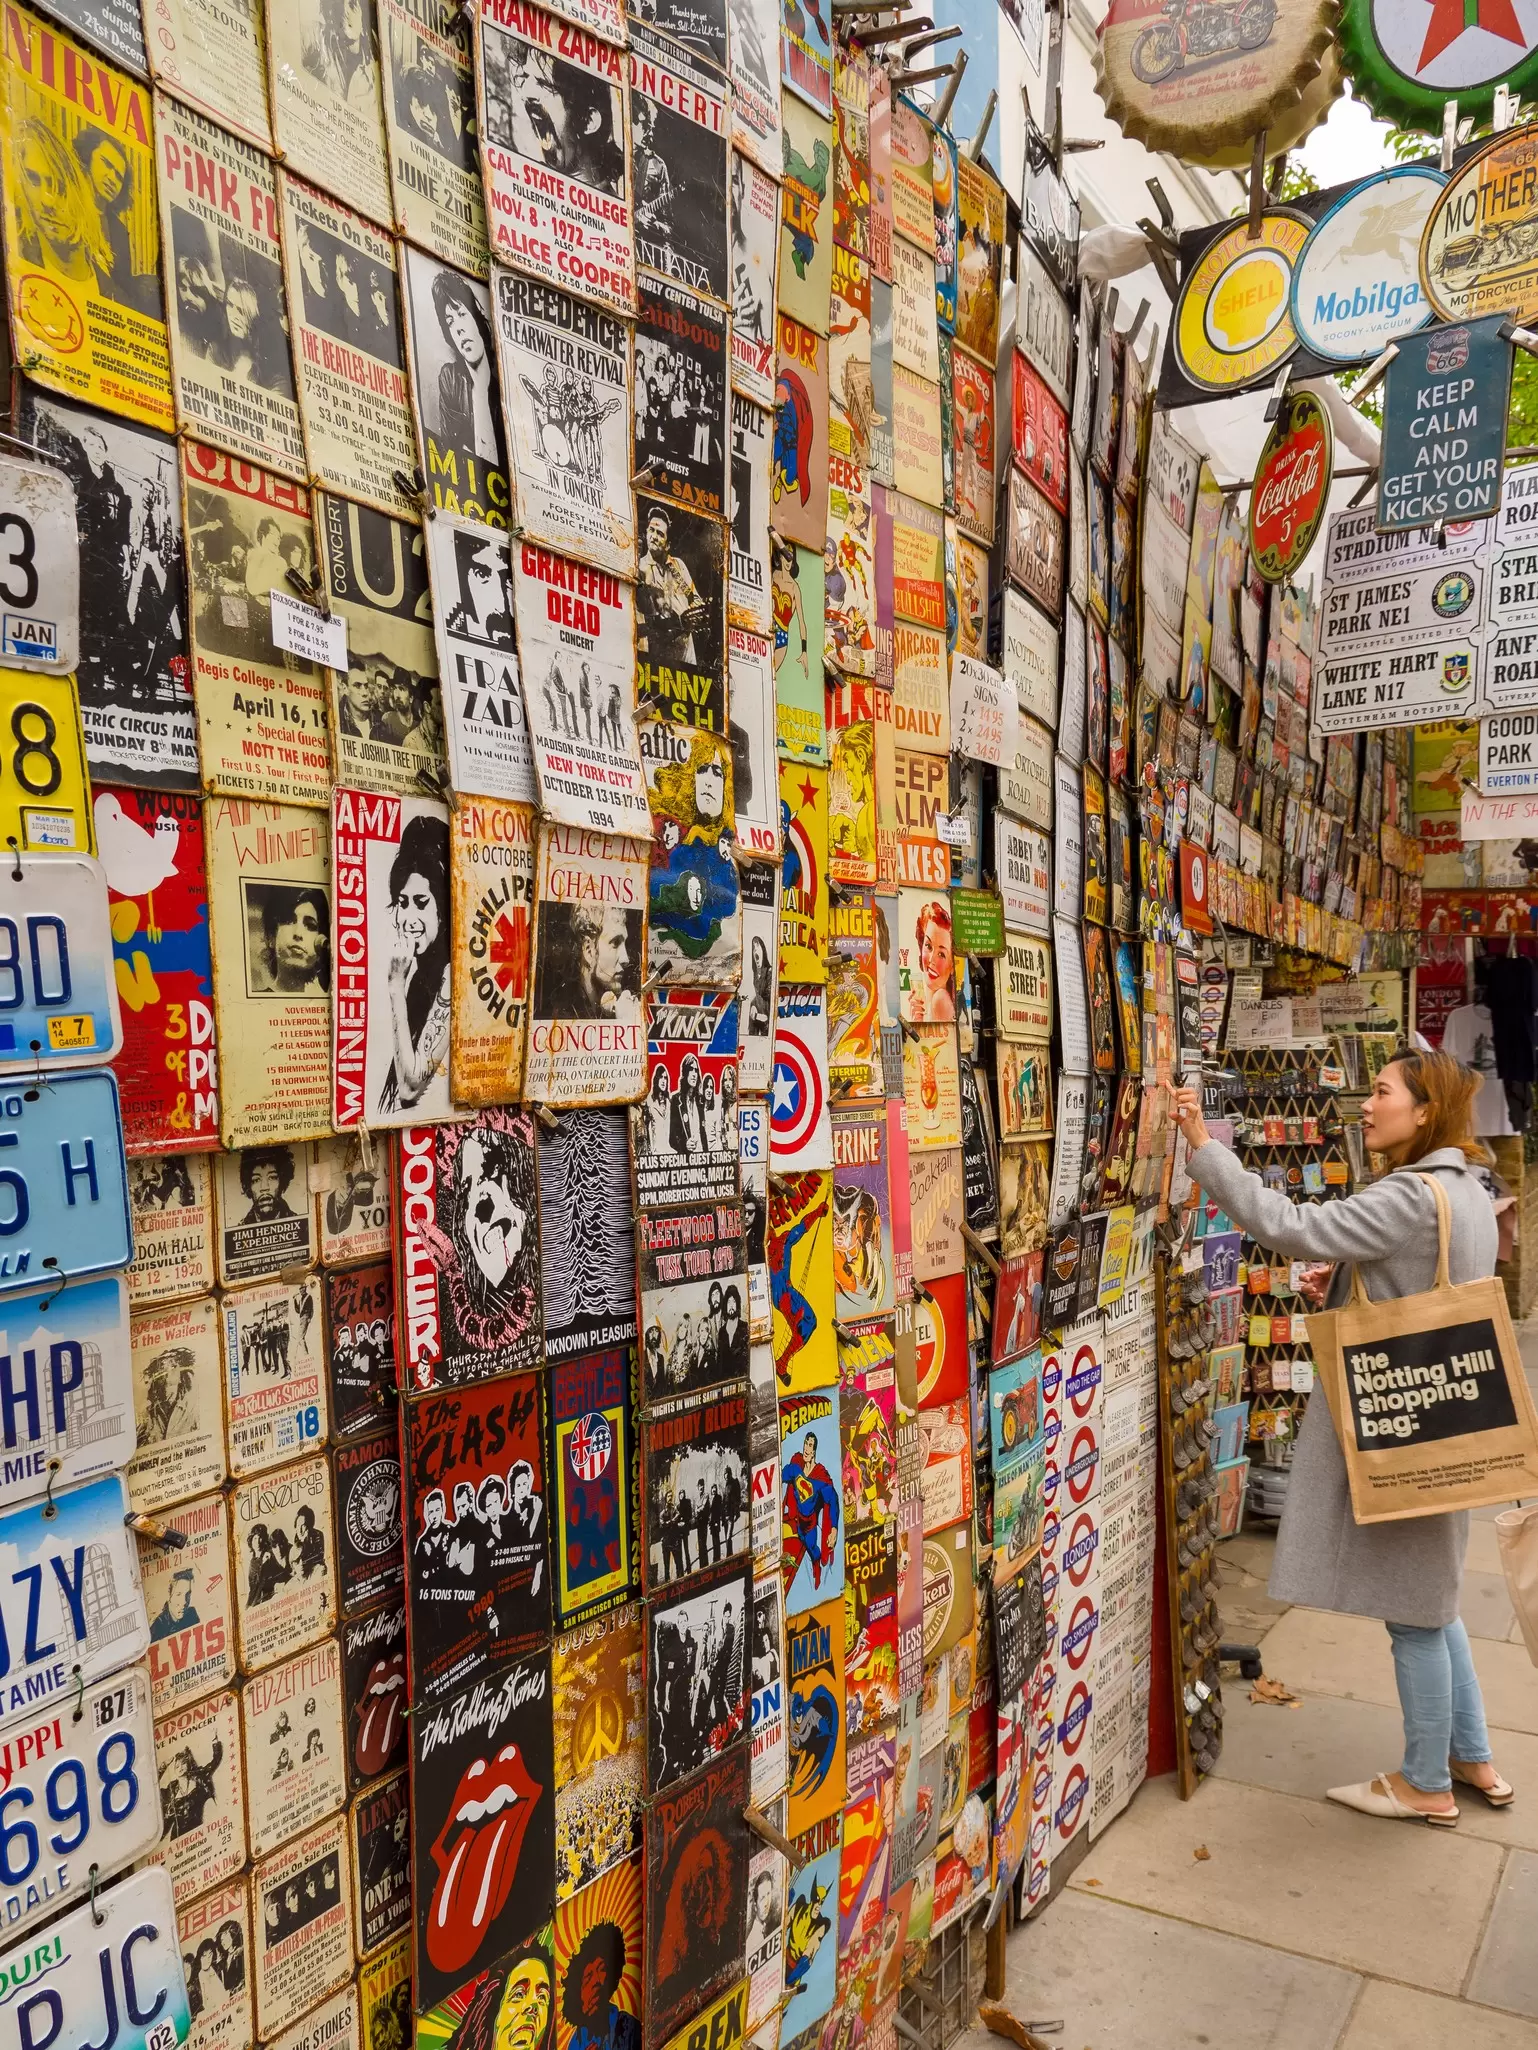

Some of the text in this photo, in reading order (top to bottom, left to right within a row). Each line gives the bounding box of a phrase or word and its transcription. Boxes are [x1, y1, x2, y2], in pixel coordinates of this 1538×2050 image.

[558, 15, 623, 82] ZAPPA
[660, 38, 692, 65] ROTTERDAM
[487, 147, 628, 228] CAL. STATE COLLEGE
[752, 168, 775, 192] EDWARD
[187, 196, 245, 245] SATURDAY
[286, 187, 392, 264] Tickets On Sale
[560, 205, 606, 233] CALIFORNIA
[551, 218, 584, 249] 1972
[554, 238, 574, 253] ALSO
[497, 227, 632, 301] ALICE COOPER
[665, 286, 724, 324] CENTER TULSA
[1450, 277, 1533, 307] MOTORCYCLE
[87, 300, 124, 321] BRISTOL
[89, 325, 125, 345] LONDON
[575, 350, 626, 388] REVIVAL
[179, 377, 220, 404] CAPTAIN
[220, 375, 295, 422] THE STEVE MILLER
[352, 385, 386, 411] STADIUM
[1417, 378, 1475, 411] KEEP
[196, 423, 228, 445] TICKETS
[214, 407, 265, 443] HARPER
[1409, 406, 1477, 439] CALM
[1275, 449, 1297, 474] DRINK
[1415, 438, 1468, 468] AND
[666, 460, 689, 476] GUESTS
[1383, 458, 1497, 498] GET YOUR
[563, 474, 603, 509] CONCERT
[672, 479, 720, 510] SAXON
[1386, 484, 1490, 522] KICKS ON
[541, 509, 575, 532] MUSIC
[548, 502, 587, 525] FOREST
[1334, 533, 1410, 564] STADIUM
[520, 546, 623, 611] GRATEFUL
[1330, 579, 1419, 613] ST JAMES'
[293, 616, 303, 626] FOR
[546, 588, 600, 637] DEAD
[1328, 606, 1410, 637] PARK NE1
[11, 621, 53, 645] JAN
[294, 629, 305, 640] FOR
[559, 629, 595, 652] CONCERT
[746, 634, 768, 657] BOND
[1334, 630, 1441, 652] NEWCASTLE UNITED
[40, 649, 54, 661] 16
[894, 629, 940, 670] SARCASM
[1325, 651, 1439, 686] WHITE HART
[233, 692, 274, 720] April
[974, 685, 998, 706] SIGNS
[1322, 682, 1405, 710] LANE N17
[119, 716, 169, 737] CIRCUS
[895, 705, 942, 737] DAILY
[1327, 703, 1460, 727] TOTTENHAM HOTSPUR
[257, 721, 295, 745] Special
[536, 735, 640, 772] MADISON SQUARE GARDEN
[1487, 742, 1532, 765] PARK
[546, 754, 632, 789] NEW YORK CITY
[1487, 774, 1530, 788] EVERTON
[544, 775, 594, 800] OCTOBER
[337, 791, 401, 839] AMY
[589, 810, 614, 828] 1994
[482, 843, 533, 869] OCTOBRE
[1007, 832, 1033, 861] ABBEY
[1008, 858, 1031, 885] ROAD
[1008, 944, 1035, 972] BAKER
[337, 834, 368, 1126] WINEHOUSE
[1009, 971, 1038, 995] STREET
[52, 1020, 62, 1030] KY
[73, 1018, 84, 1037] 7
[659, 1005, 715, 1043] KINKS
[58, 1036, 91, 1048] G405877
[531, 1024, 642, 1053] CONCERT
[556, 1084, 604, 1096] NOVEMBER
[660, 1151, 732, 1167] SPECIAL GUEST STARS
[638, 1167, 708, 1189] SUNDAY EVENING,
[232, 1221, 301, 1242] JIMI HENDRIX
[234, 1231, 299, 1250] EXPERIENCE
[641, 1205, 741, 1251] FLEETWOOD MAC
[174, 1263, 203, 1279] 1970
[656, 1245, 733, 1281] TUSK TOUR 1979
[1049, 1282, 1077, 1302] PARKING
[446, 1338, 527, 1368] THURSDAY APRIL
[1106, 1339, 1138, 1364] DRUG FREE
[1351, 1353, 1390, 1375] the
[1067, 1369, 1100, 1393] MIND THE GAP
[1115, 1359, 1130, 1378] ZONE
[1353, 1348, 1496, 1395] Notting Hill
[1358, 1379, 1480, 1414] shopping
[250, 1422, 271, 1438] HAVEN
[296, 1406, 319, 1440] 18
[704, 1400, 745, 1434] BLUES
[1360, 1413, 1421, 1438] bag:
[278, 1436, 294, 1448] JUNE
[1066, 1452, 1098, 1477] UNDERGROUND
[1066, 1534, 1097, 1567] LONDON
[853, 1555, 886, 1585] FOUR
[419, 1589, 476, 1601] 16 TONS TOUR
[1063, 1615, 1097, 1649] NO SMOKING
[100, 1688, 126, 1726] 87
[1066, 1705, 1085, 1733] TOILET
[207, 1816, 229, 1832] TOUR
[364, 1882, 393, 1913] ONE
[313, 2006, 352, 2049] STONES
